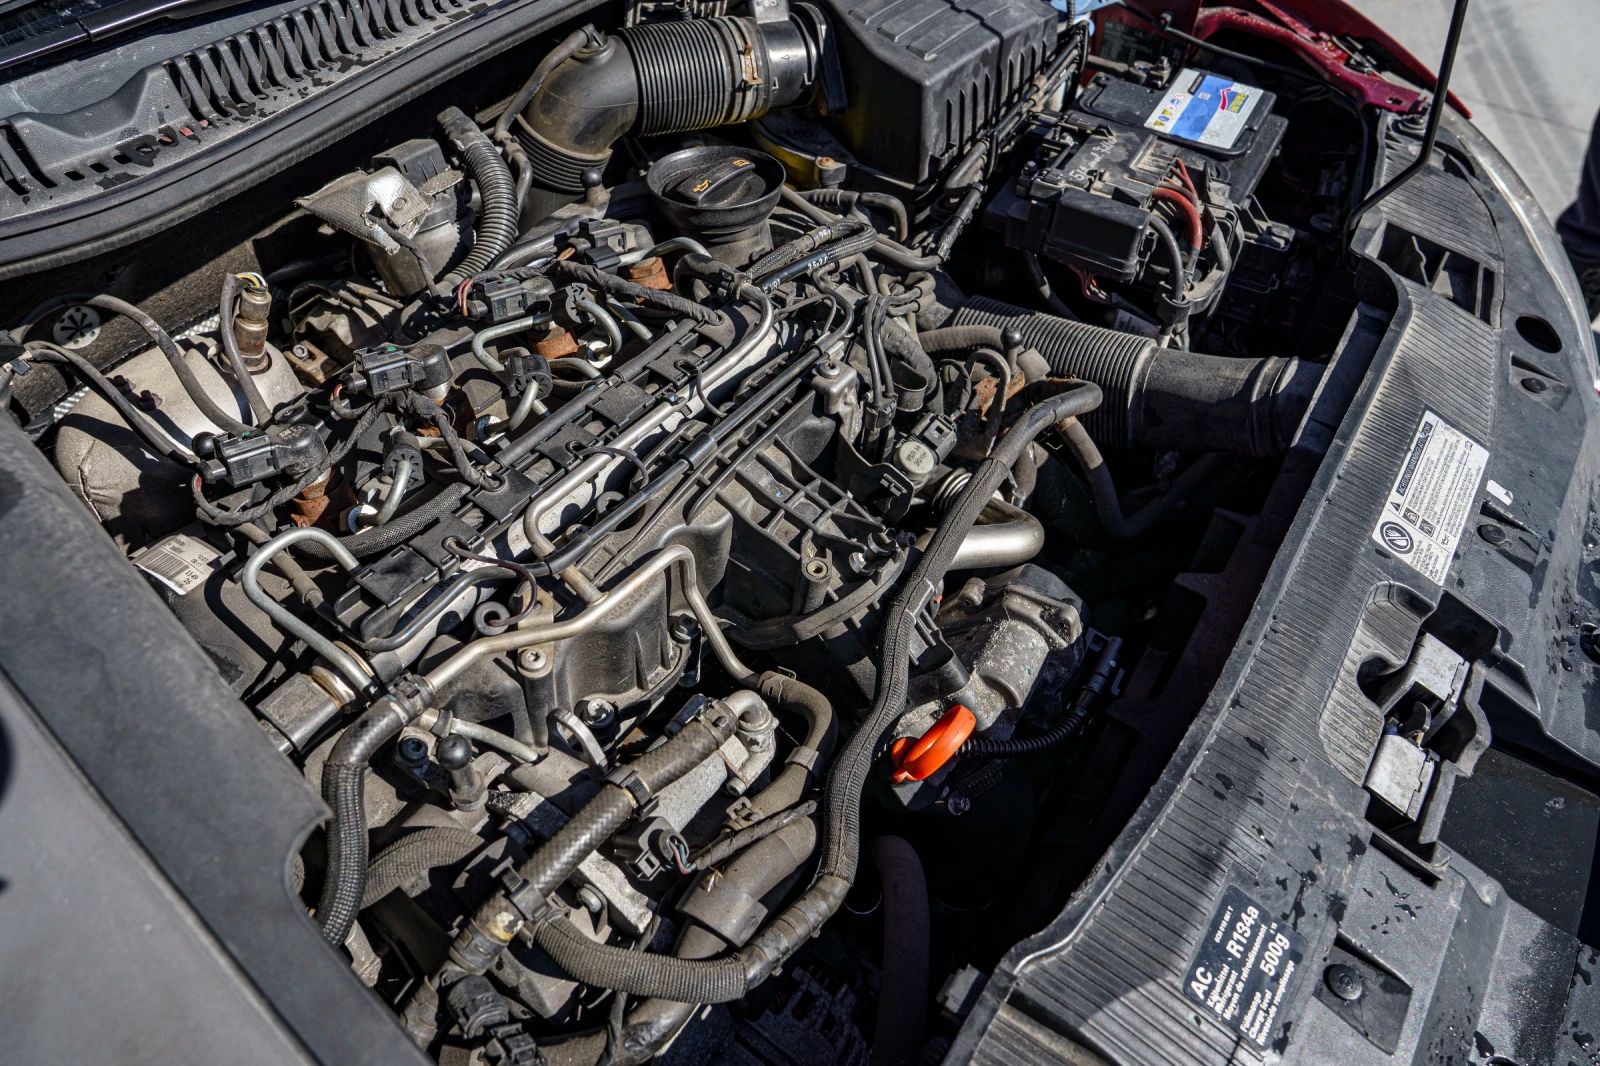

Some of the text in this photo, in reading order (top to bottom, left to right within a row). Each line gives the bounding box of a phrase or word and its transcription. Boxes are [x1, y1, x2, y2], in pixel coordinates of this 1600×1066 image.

[1225, 905, 1260, 959] R134a
[1259, 928, 1291, 977] 500g
[1190, 966, 1213, 1001] AC
[1222, 923, 1268, 1021] Moyen de refroidissement
[1272, 959, 1295, 1006] remplissage
[1239, 991, 1262, 1035] Füllmenge
[1248, 988, 1273, 1041] Charge level
